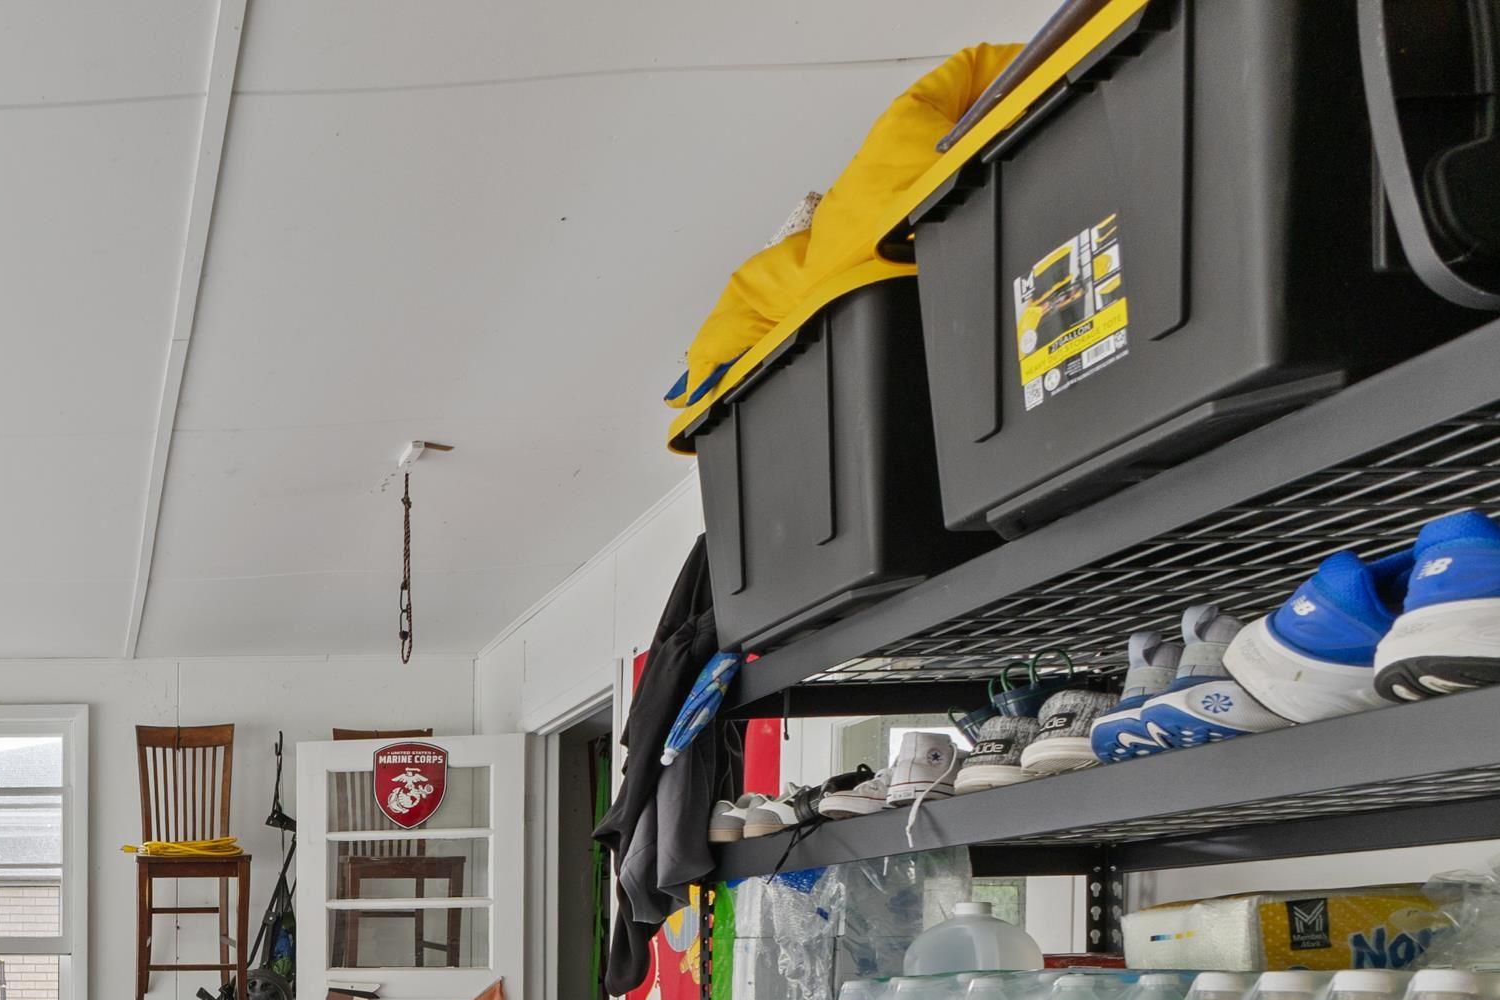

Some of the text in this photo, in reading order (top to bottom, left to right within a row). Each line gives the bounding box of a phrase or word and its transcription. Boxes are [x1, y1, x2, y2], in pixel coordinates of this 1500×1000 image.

[1058, 322, 1092, 345] GALLON
[379, 755, 444, 764] MARINE CORPS
